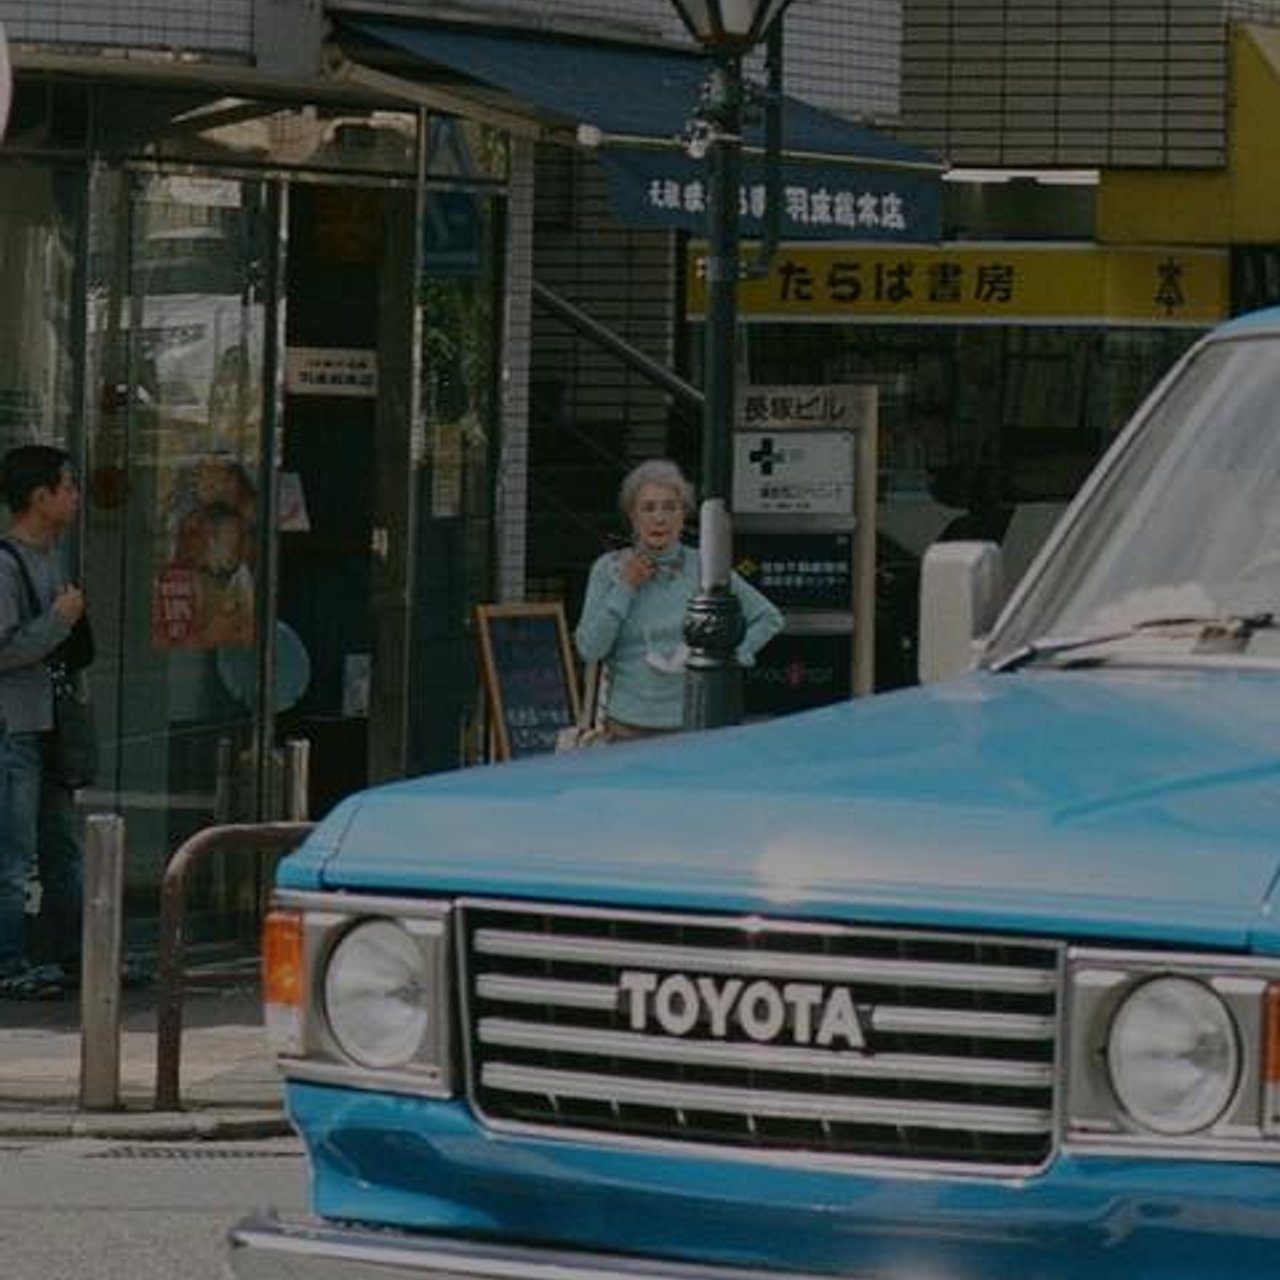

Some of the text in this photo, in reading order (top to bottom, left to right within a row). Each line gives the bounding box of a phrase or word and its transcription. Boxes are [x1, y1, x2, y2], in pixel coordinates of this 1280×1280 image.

[776, 263, 1015, 303] たらば書房
[619, 972, 867, 1050] TOYOTA
